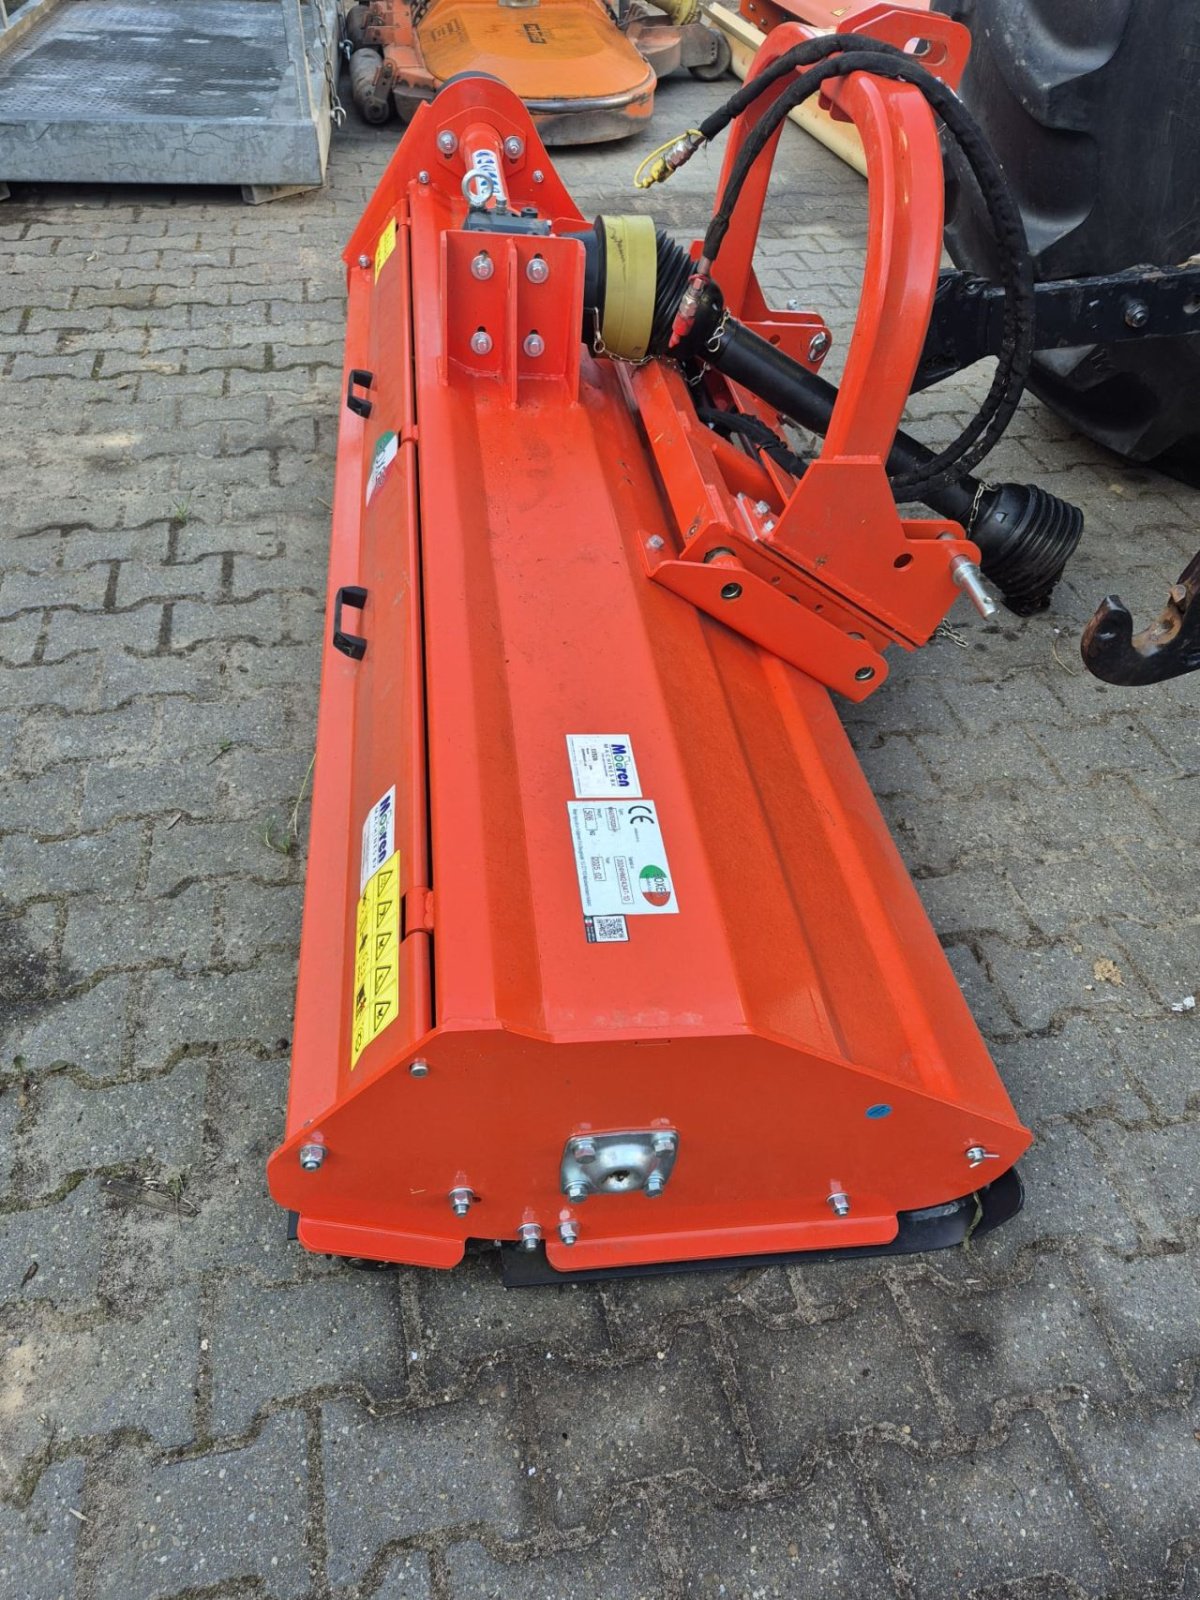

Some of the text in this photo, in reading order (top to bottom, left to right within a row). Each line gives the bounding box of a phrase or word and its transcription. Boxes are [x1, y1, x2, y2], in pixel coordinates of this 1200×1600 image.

[604, 744, 615, 777] MACHINES
[611, 744, 630, 787] Mooren
[379, 795, 391, 864] Mooren
[628, 805, 655, 824] CE
